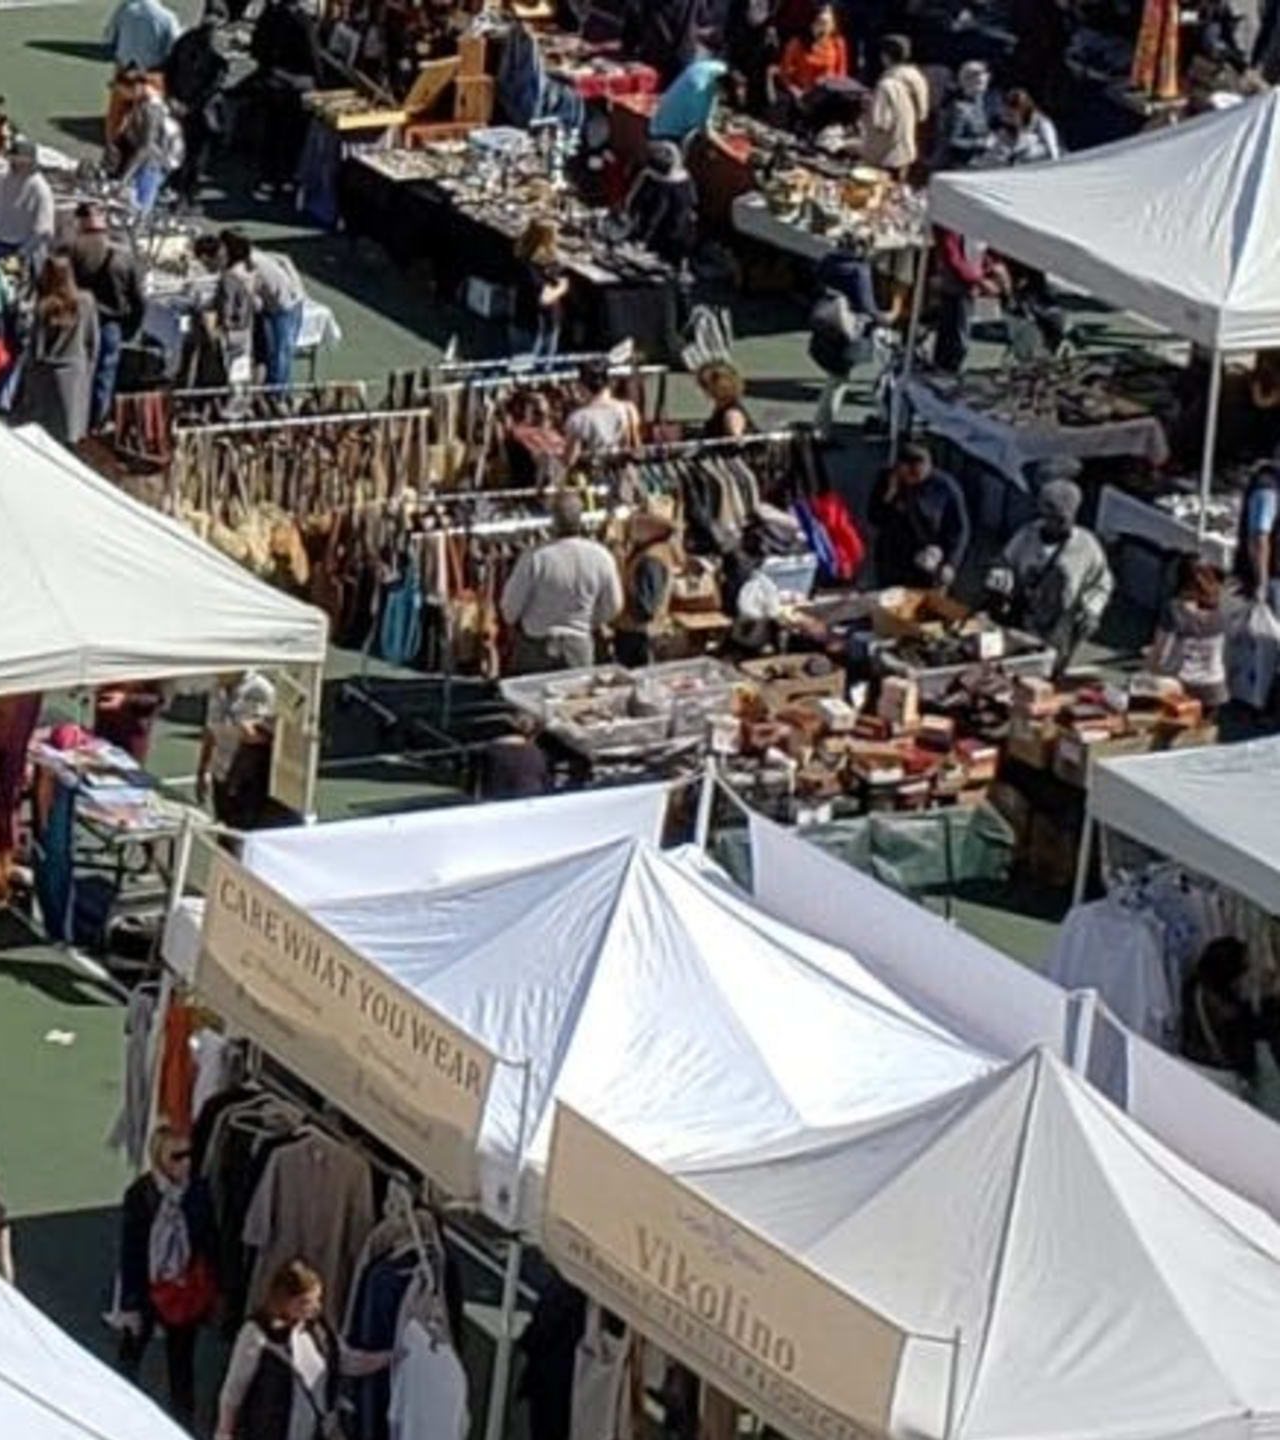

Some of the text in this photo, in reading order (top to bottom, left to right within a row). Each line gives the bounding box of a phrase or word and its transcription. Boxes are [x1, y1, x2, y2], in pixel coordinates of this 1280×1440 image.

[219, 878, 279, 942] CARE
[280, 929, 354, 999] WHAT
[357, 979, 408, 1040] YOU
[409, 1014, 482, 1096] WEAR
[631, 1226, 797, 1371] Vikolino
